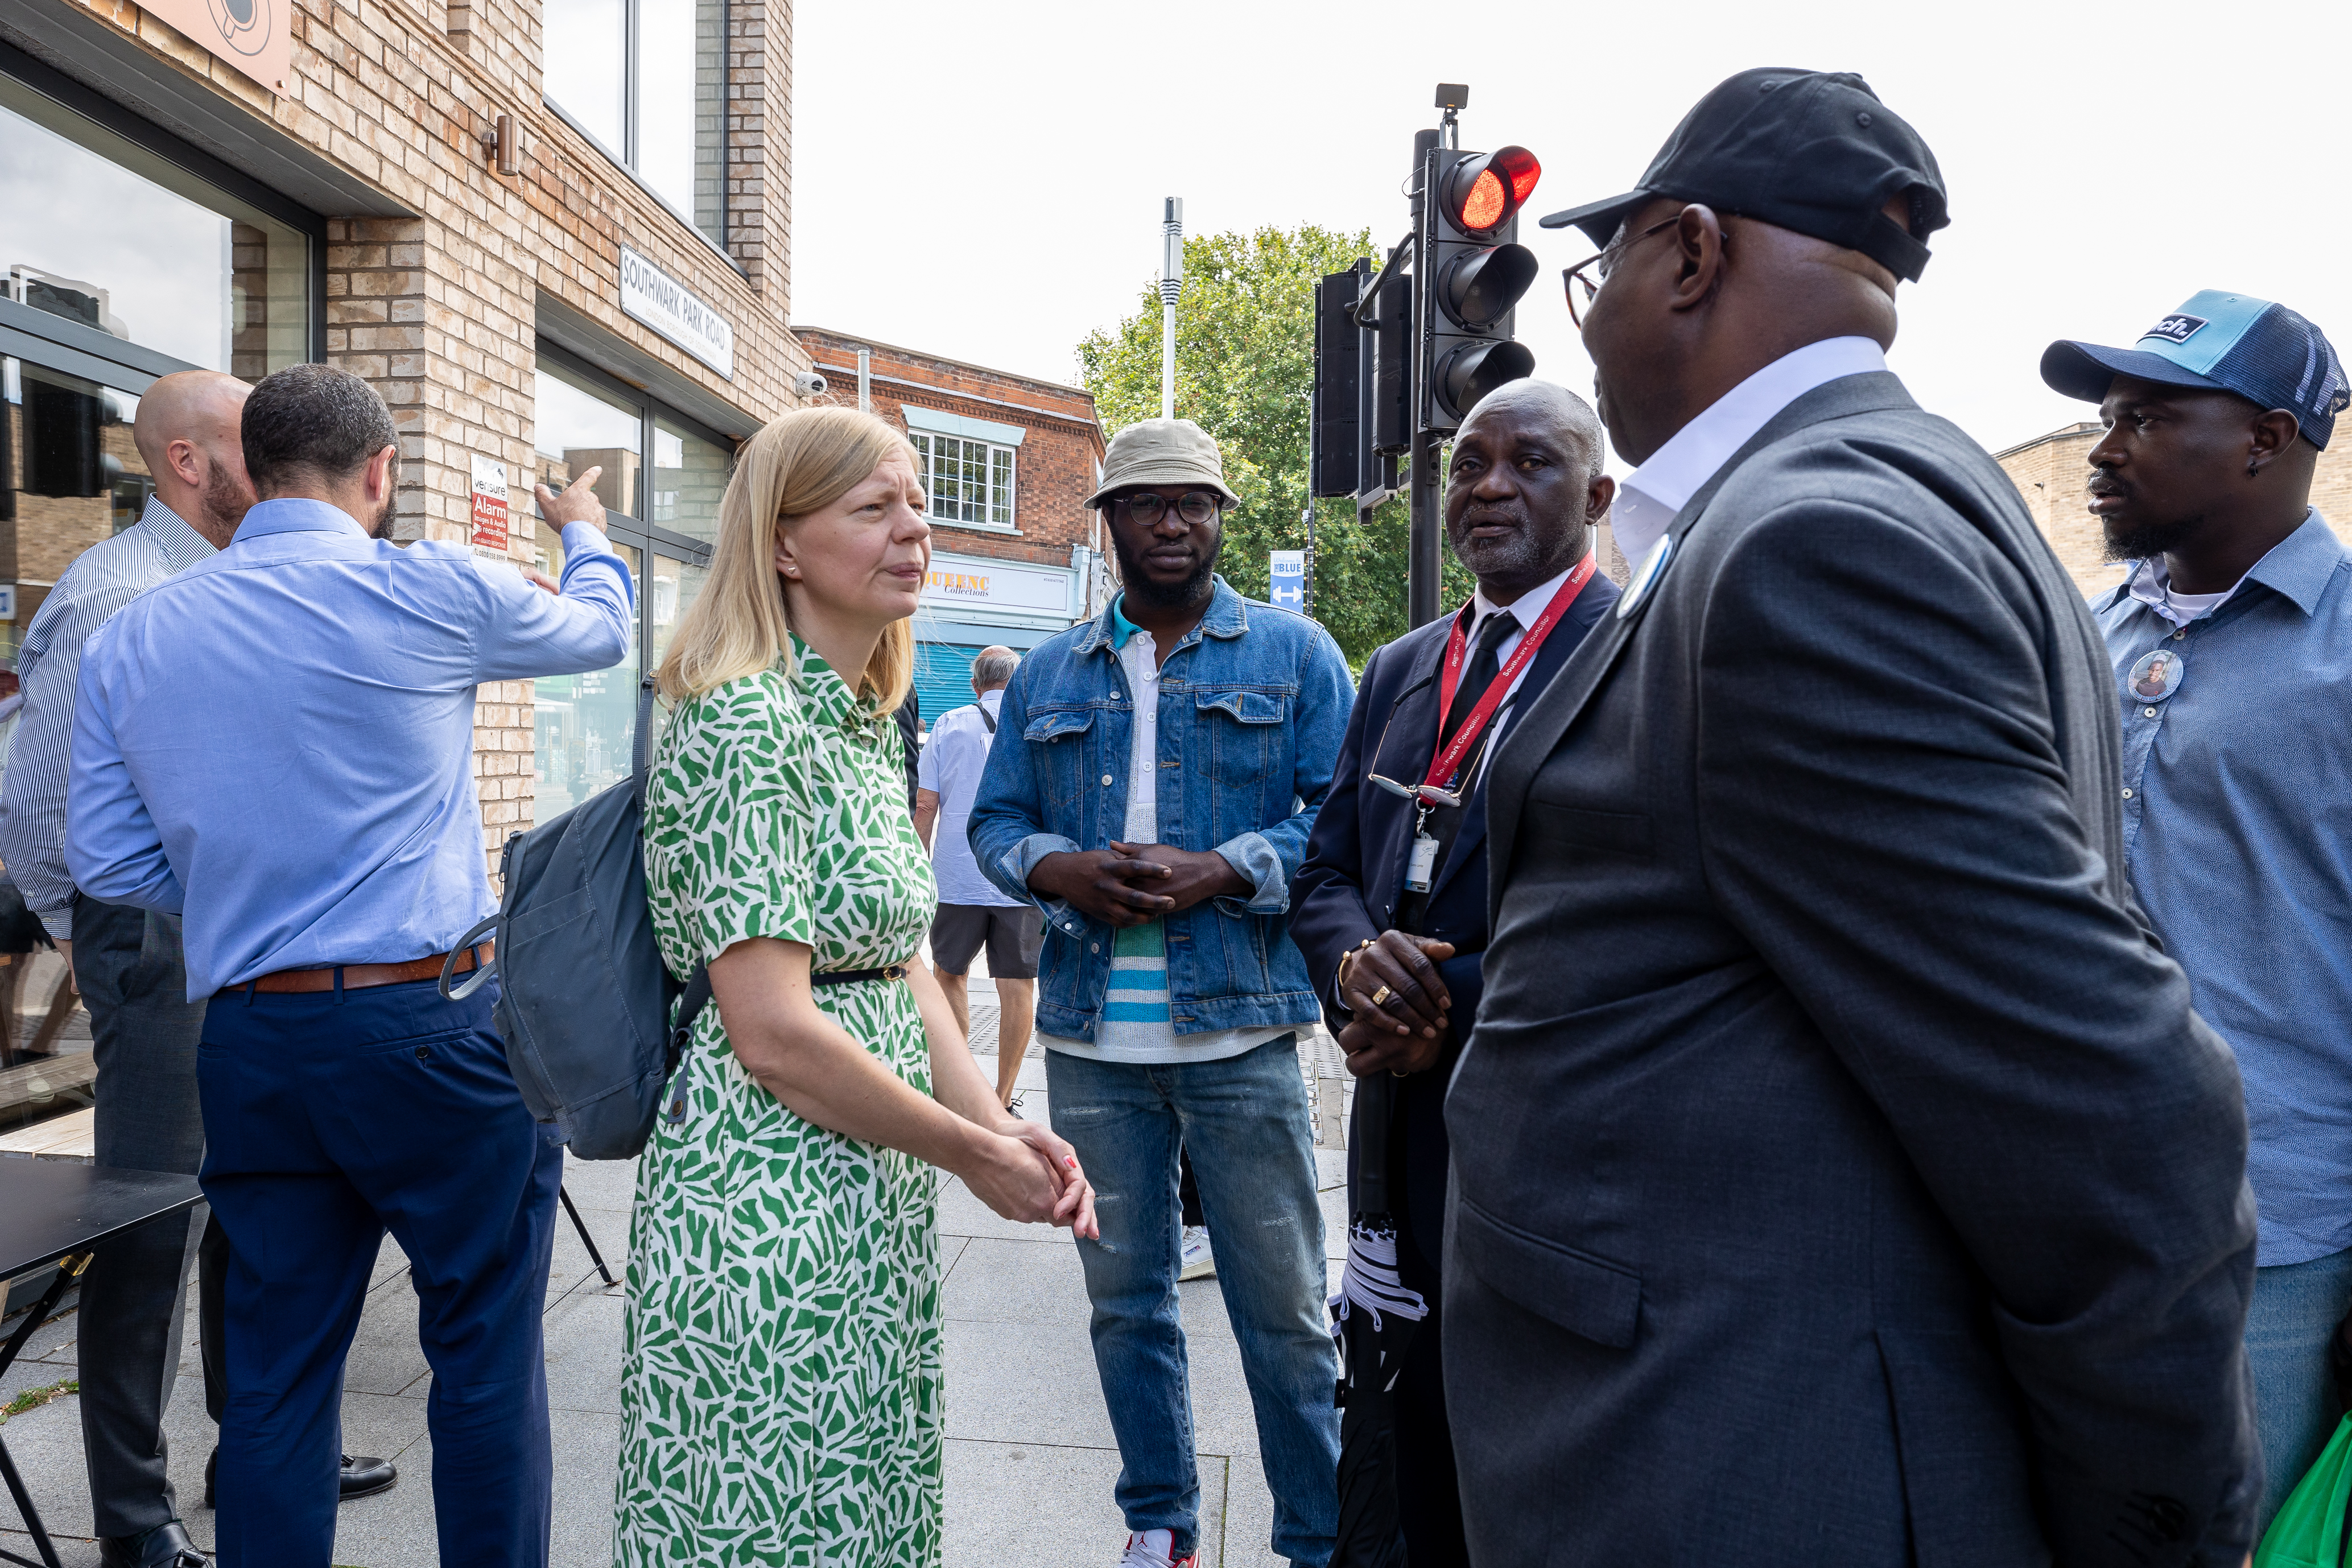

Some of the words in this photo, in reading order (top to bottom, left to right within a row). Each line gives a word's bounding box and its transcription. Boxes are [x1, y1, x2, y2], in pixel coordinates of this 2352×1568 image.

[624, 254, 680, 319] SOUTHWARK
[683, 296, 703, 335] PARK
[705, 313, 725, 350] ROAD
[646, 306, 666, 327] LONDON
[667, 320, 687, 341] BOROUGH
[688, 336, 695, 345] OF
[474, 478, 505, 496] verisure
[474, 496, 506, 519] Alarm
[474, 513, 489, 525] Images
[494, 519, 506, 529] Audio
[482, 526, 506, 540] recording
[1279, 563, 1301, 572] BLUE
[944, 584, 989, 597] Collections
[1503, 647, 1528, 676] Southwark
[1526, 615, 1550, 646] Councillor
[1435, 745, 1461, 777] Southwark
[1457, 713, 1482, 744] Councillor
